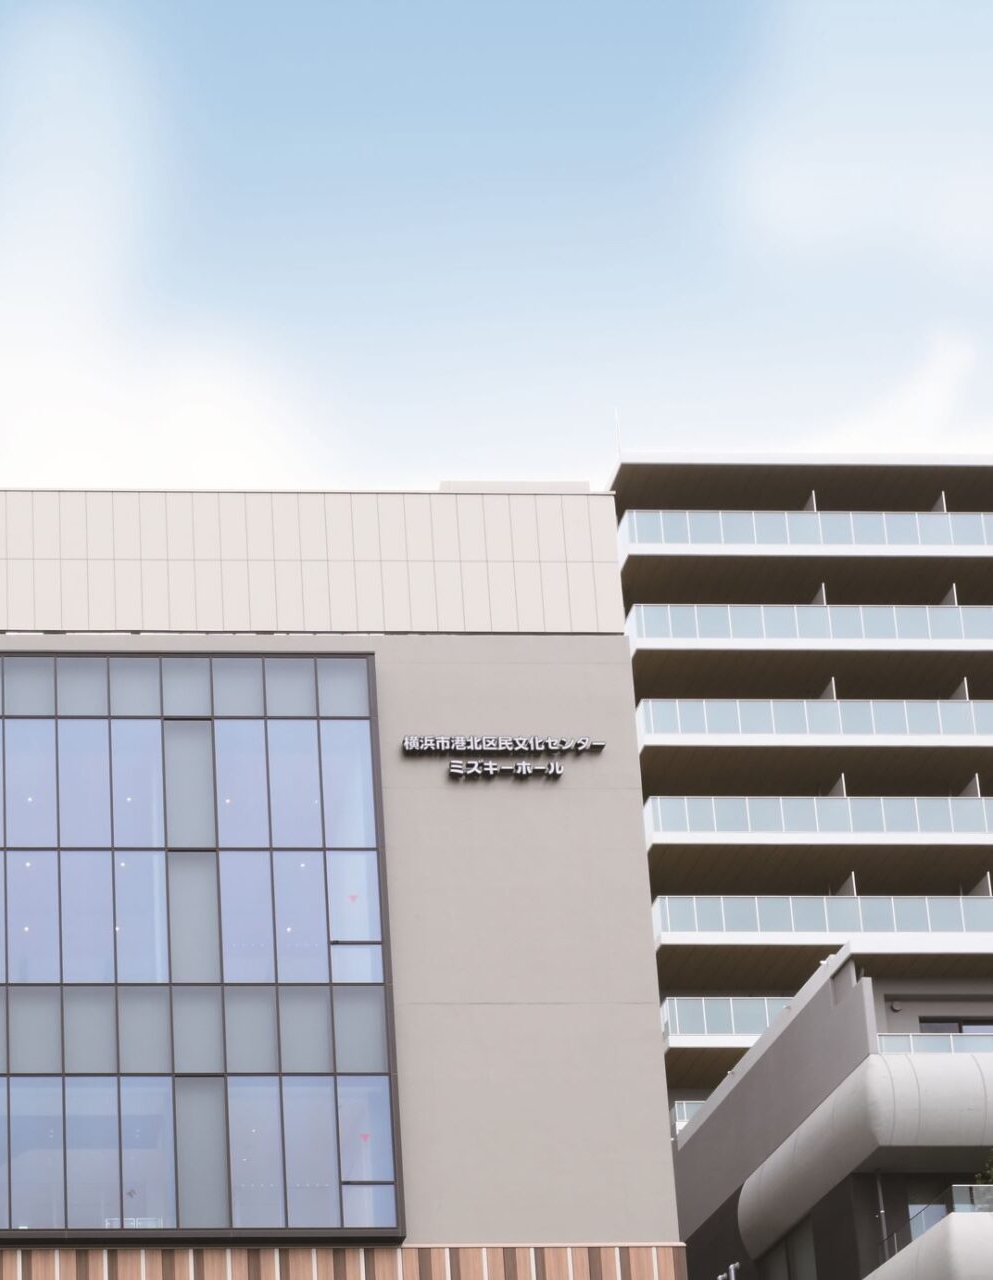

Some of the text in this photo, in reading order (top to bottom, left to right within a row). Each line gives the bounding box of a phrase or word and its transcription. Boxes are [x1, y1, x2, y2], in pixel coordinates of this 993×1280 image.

[403, 735, 606, 753] 横浜市港北区民文化センター
[449, 758, 563, 777] ミズキーホール
